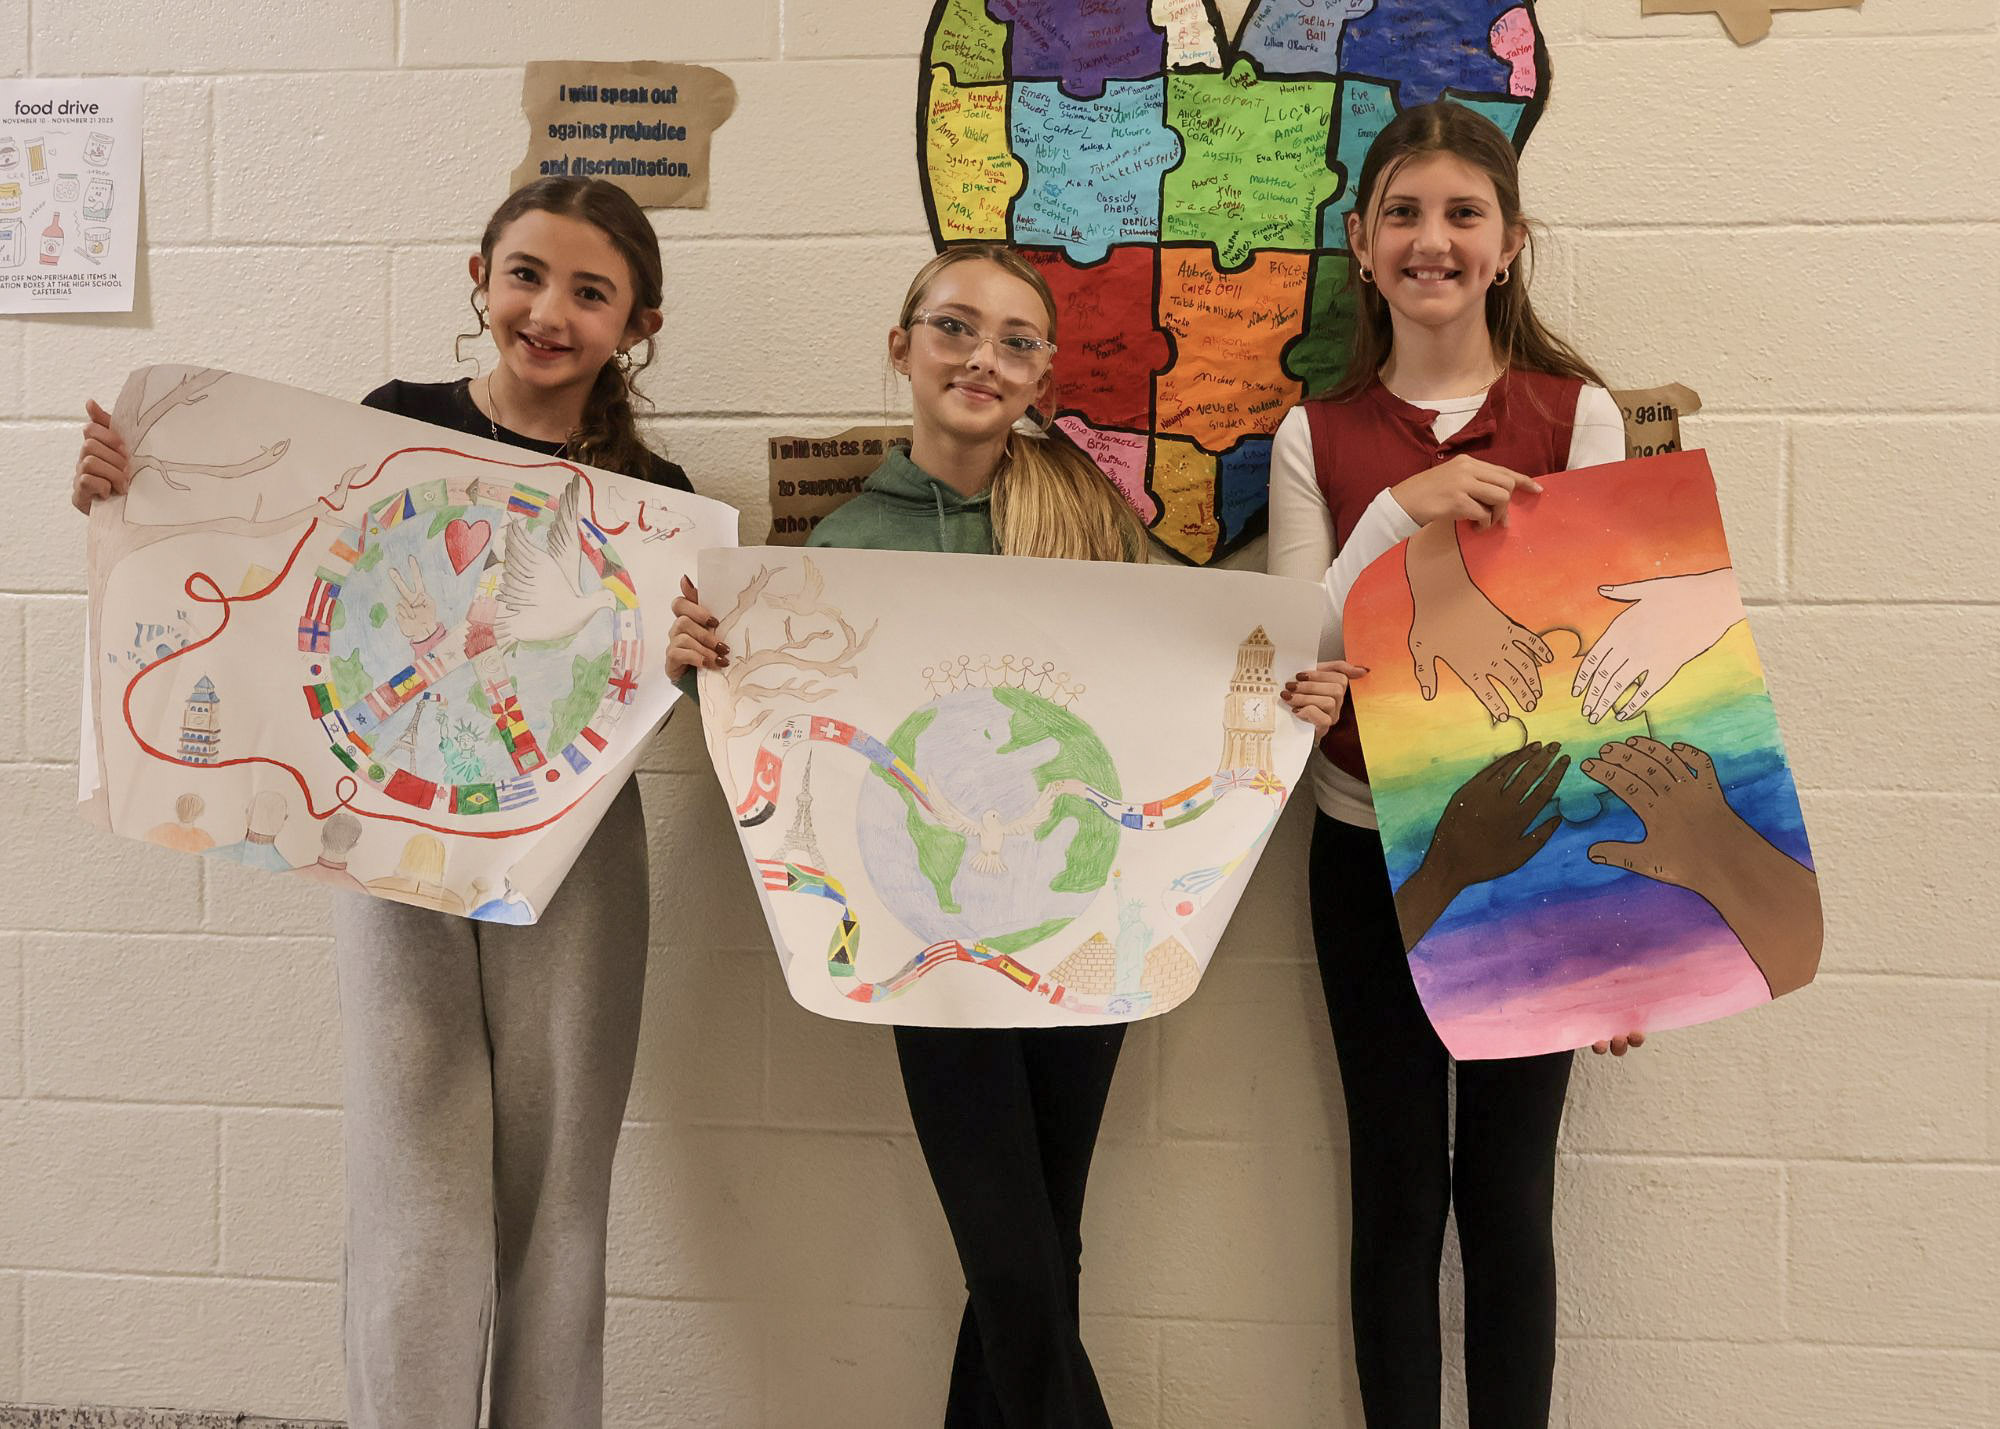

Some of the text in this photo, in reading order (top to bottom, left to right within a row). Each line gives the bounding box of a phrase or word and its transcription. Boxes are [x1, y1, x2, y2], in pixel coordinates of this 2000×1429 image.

[560, 85, 678, 105] I will speak out
[1021, 85, 1052, 108] Emery
[1351, 87, 1369, 101] Eve
[15, 100, 99, 115] food drive
[962, 108, 992, 120] Joelle
[1018, 96, 1049, 117] Powers
[548, 120, 686, 144] against prejudice
[936, 122, 960, 148] Anna
[540, 154, 691, 178] and discrimination.
[945, 153, 984, 171] Sydney
[1256, 154, 1272, 163] Eva
[1096, 189, 1136, 203] Cassidy
[1253, 190, 1298, 205] Callahan
[947, 201, 975, 220] Max
[1635, 402, 1673, 425] gain
[771, 441, 777, 460] I
[780, 440, 810, 460] will
[811, 440, 839, 458] act
[839, 441, 859, 455] as
[1086, 438, 1110, 452] Bryn
[778, 480, 795, 496] to
[773, 515, 808, 533] who
